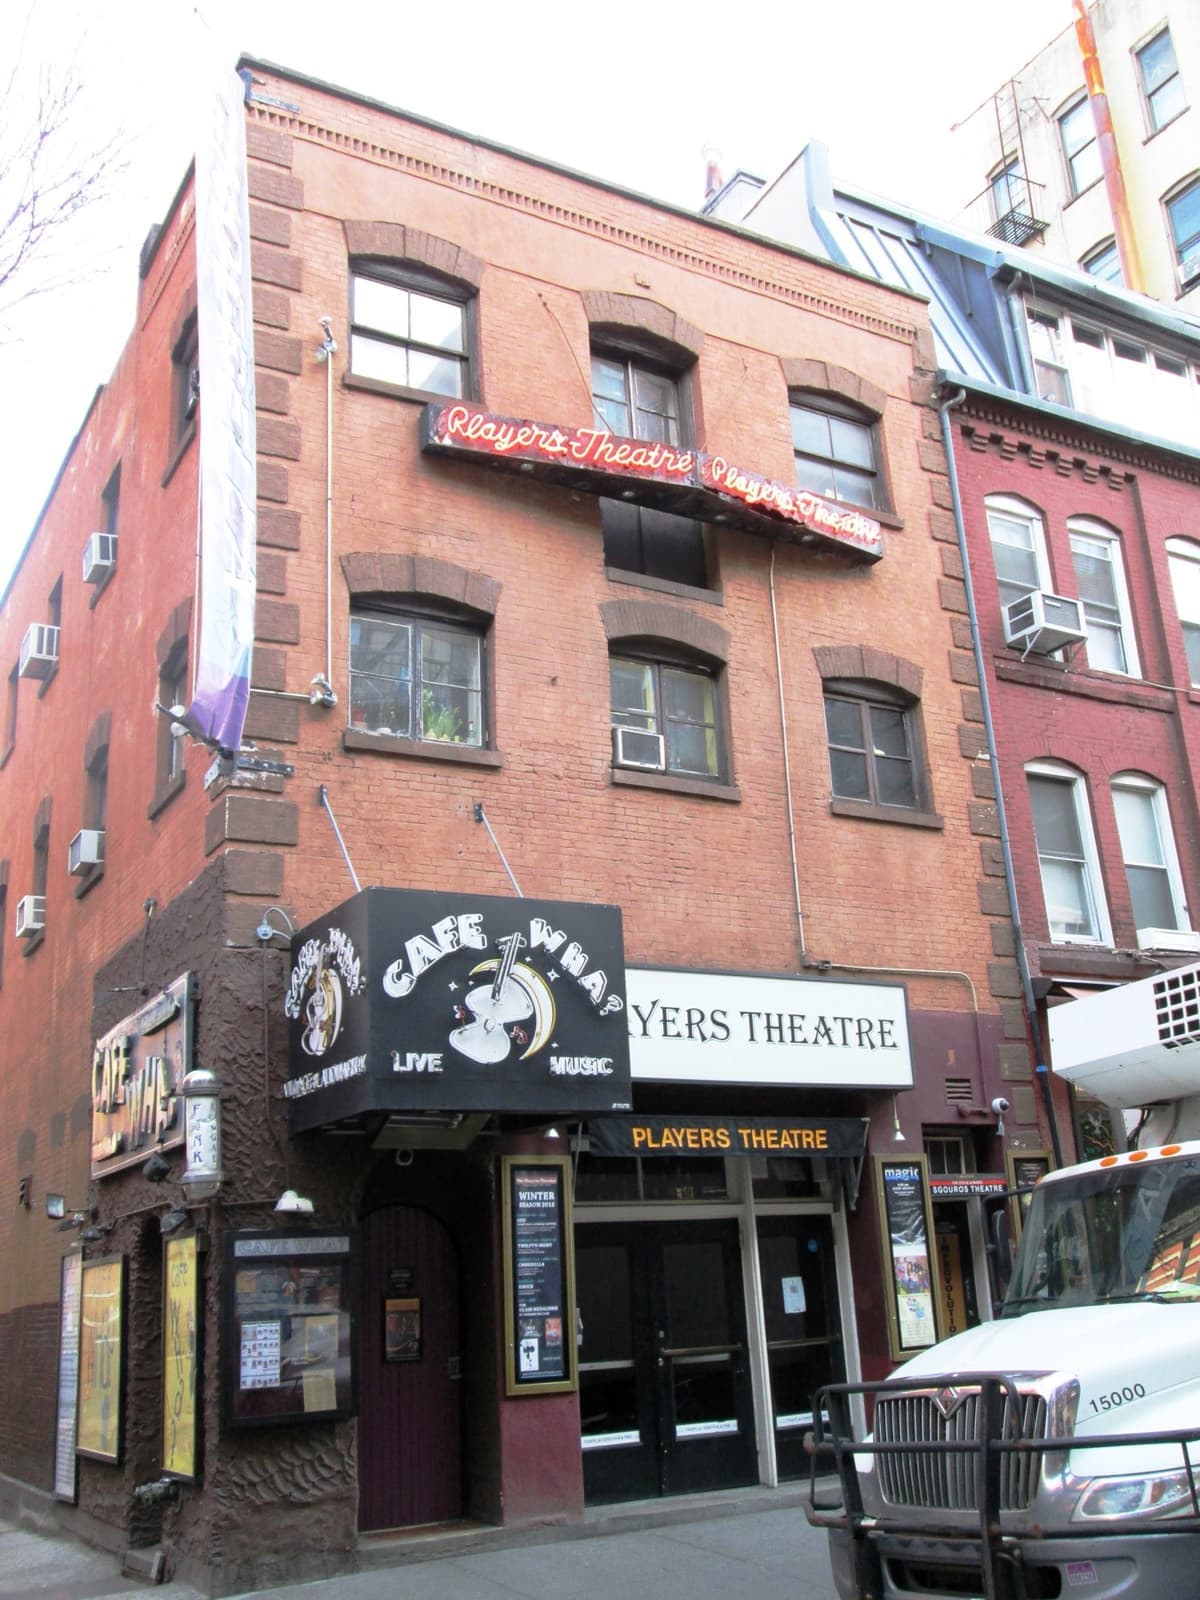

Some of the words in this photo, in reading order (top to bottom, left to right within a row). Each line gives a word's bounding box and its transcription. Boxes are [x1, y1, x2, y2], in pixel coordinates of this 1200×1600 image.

[446, 405, 568, 456] Players
[568, 428, 694, 471] Theatre
[711, 456, 796, 512] Players
[383, 912, 487, 998] CAFE
[628, 998, 731, 1043] YERS
[740, 1010, 898, 1051] THEATRE
[391, 1050, 444, 1073] LIVE
[632, 1126, 731, 1148] PLAYERS
[738, 1128, 829, 1149] THEATRE
[884, 1166, 920, 1181] magic
[518, 1191, 555, 1201] WINTER
[932, 1185, 969, 1194] SGOUROS
[970, 1184, 1004, 1193] THEATRE
[518, 1201, 541, 1209] SEASON
[1088, 1382, 1146, 1414] 15000
